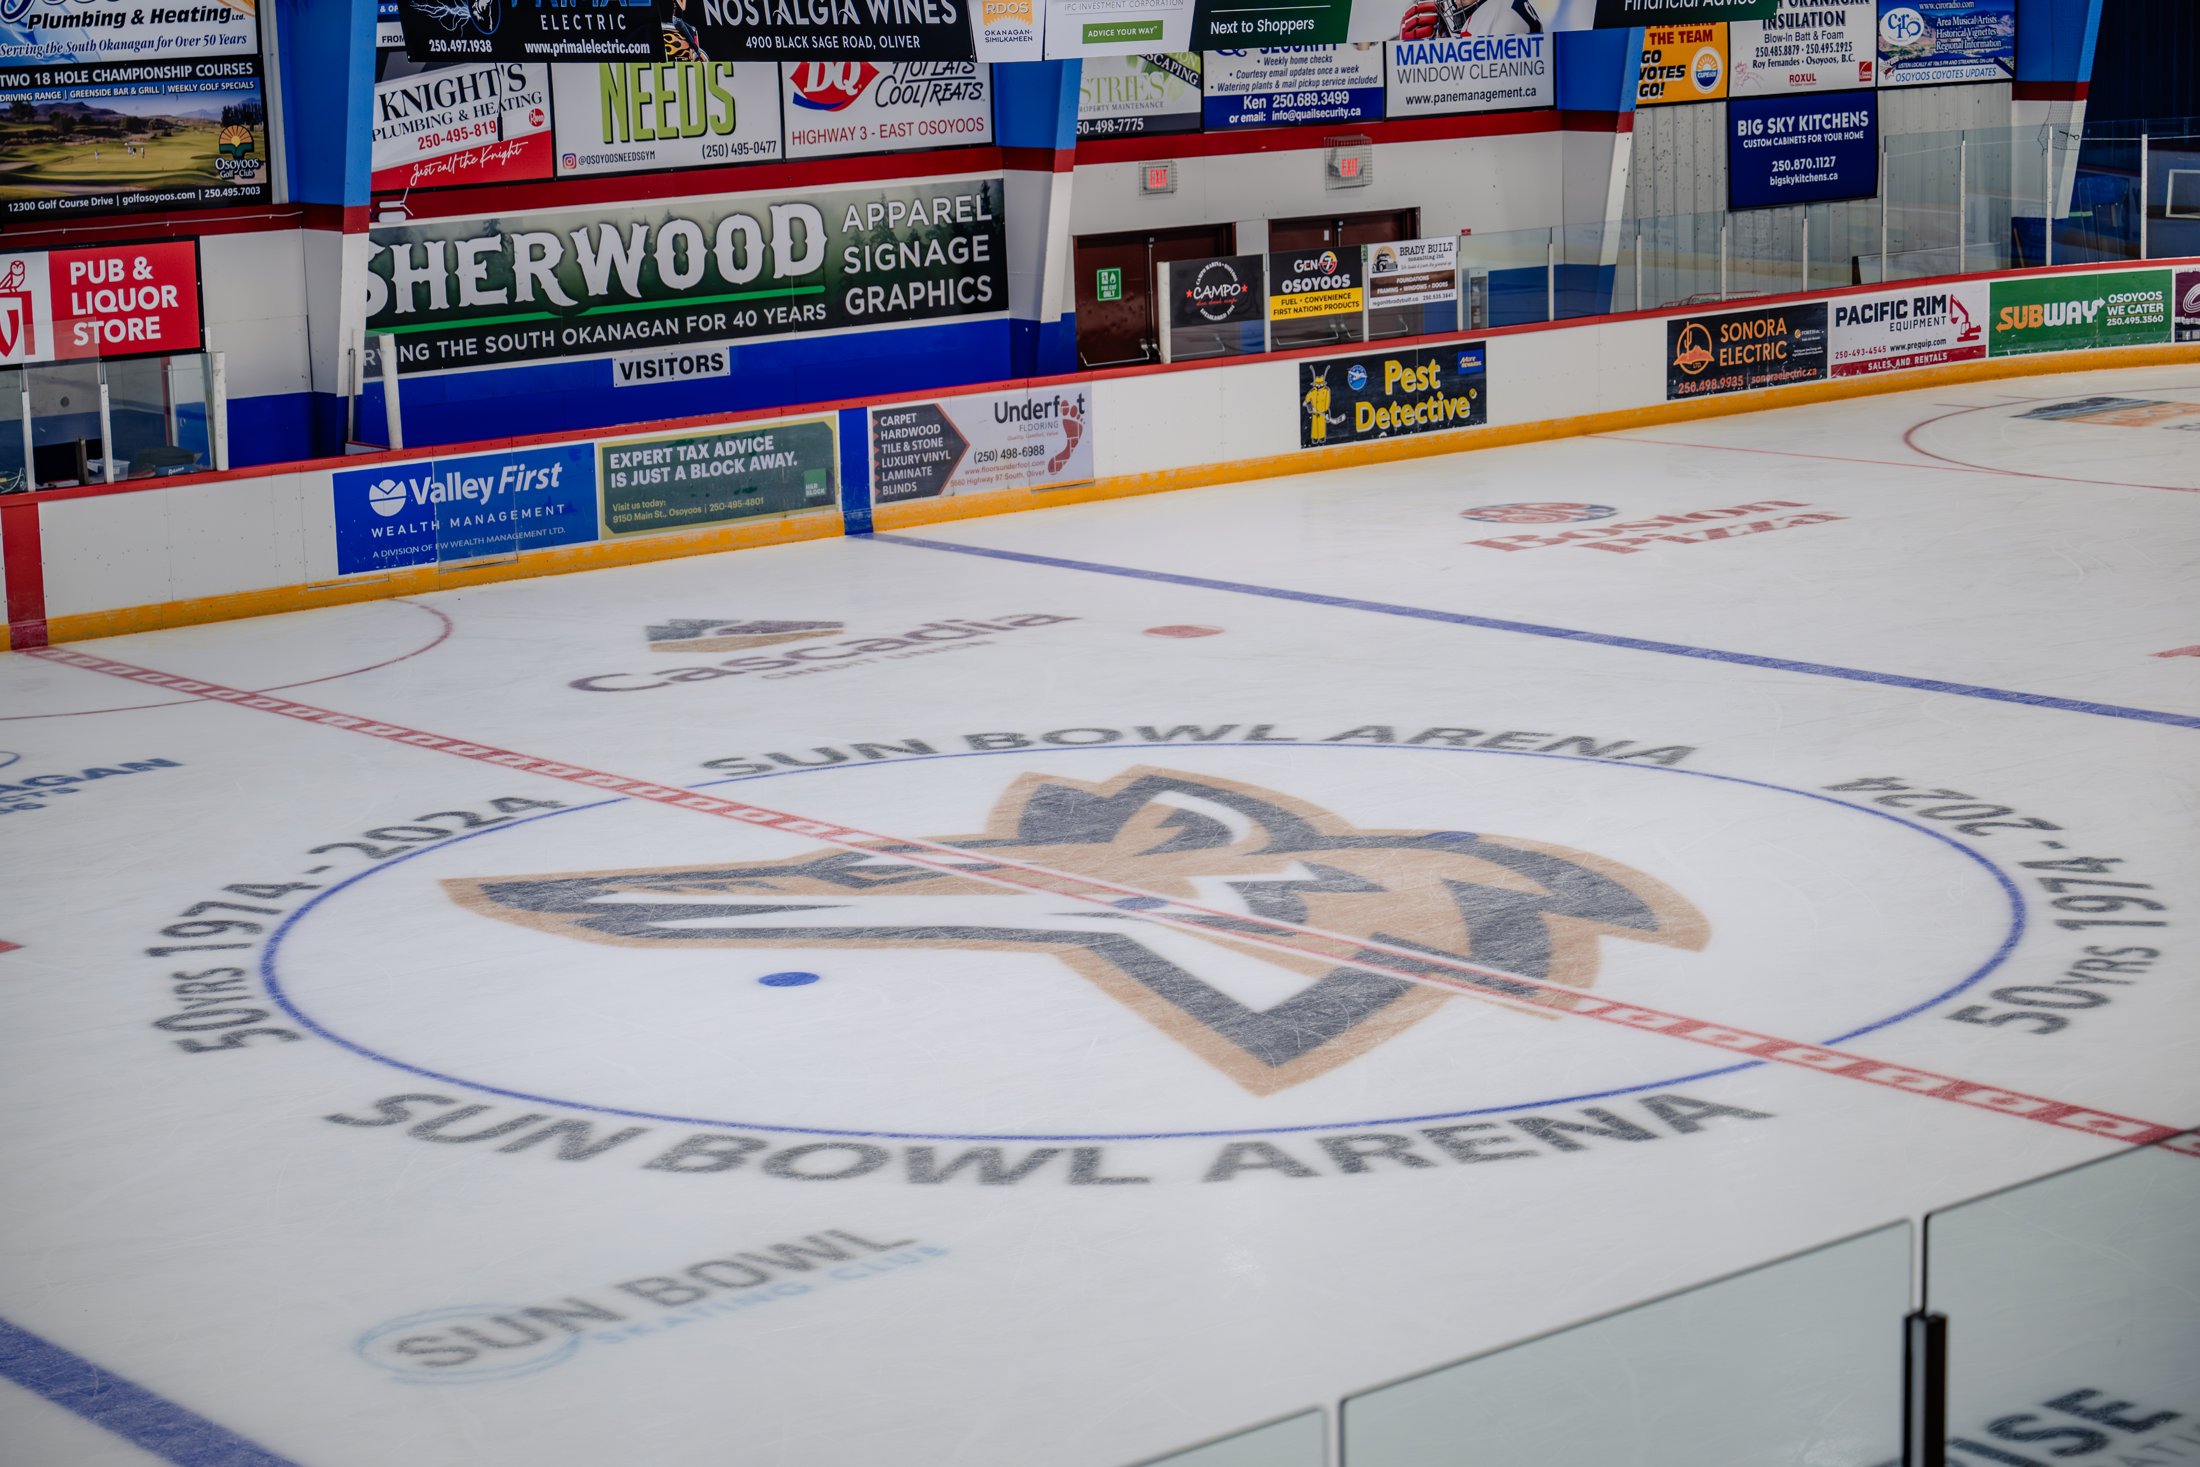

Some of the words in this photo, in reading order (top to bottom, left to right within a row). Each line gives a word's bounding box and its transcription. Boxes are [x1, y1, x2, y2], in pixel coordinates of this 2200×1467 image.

[985, 1, 1029, 15] RDOS
[540, 14, 627, 30] ELECTRIC
[1210, 20, 1238, 35] Next
[1241, 21, 1253, 33] to
[1257, 18, 1315, 35] Shoppers
[1762, 10, 1847, 30] INSULATION
[1, 43, 43, 58] Serving
[45, 42, 63, 53] the
[67, 39, 97, 52] South
[99, 37, 154, 53] Okanagan
[157, 36, 174, 52] for
[175, 35, 200, 48] Over
[203, 34, 216, 47] 50
[219, 33, 247, 46] Years
[429, 39, 492, 53] 250.497.1938
[746, 36, 773, 49] 4900
[775, 36, 810, 49] BLACK
[812, 36, 839, 49] SAGE
[842, 36, 876, 50] ROAD,
[879, 35, 920, 48] OLIVER
[1649, 32, 1675, 45] THE
[1678, 29, 1714, 43] TEAM
[525, 38, 650, 57] www.primalelectric.com
[1396, 37, 1545, 66] MANAGEMENT
[0, 74, 30, 87] TWO
[35, 73, 50, 85] 18
[55, 70, 88, 85] HOLE
[93, 65, 192, 83] CHAMPIONSHIP
[196, 63, 254, 78] COURSES
[1397, 64, 1466, 84] WINDOW
[1469, 60, 1545, 79] CLEANING
[1789, 73, 1817, 83] ROXUL
[1895, 71, 1931, 82] OSOYOOS
[1932, 69, 1964, 80] COYOTES
[1965, 68, 1997, 78] UPDATES
[378, 64, 527, 122] KNIGHT'S
[1243, 95, 1267, 110] Ken
[1272, 91, 1350, 109] 250.689.3499
[1405, 87, 1537, 105] www.panemanagement.ca
[600, 62, 738, 146] NEEDS
[372, 111, 453, 142] PLUMBING
[458, 109, 469, 121] &
[473, 91, 543, 117] HEATING
[1229, 114, 1238, 123] or
[1240, 112, 1266, 123] email:
[1272, 107, 1361, 121] info@quailsecurity.ca
[1737, 119, 1763, 137] BIG
[1768, 116, 1795, 134] SKY
[1799, 111, 1869, 132] KITCHENS
[792, 126, 857, 146] HIGHWAY
[859, 125, 868, 140] 3
[879, 122, 914, 140] EAST
[918, 117, 985, 136] OSOYOOS
[1743, 138, 1772, 148] CUSTOM
[1773, 136, 1807, 147] CABINETS
[1808, 135, 1822, 144] FOR
[1823, 133, 1843, 142] YOUR
[1844, 130, 1864, 141] HOME
[701, 143, 729, 160] (250)
[730, 140, 777, 157] 495-0477
[215, 157, 259, 172] Osoyoos
[1341, 158, 1359, 177] EXIT
[1772, 156, 1837, 173] 250.870.1127
[1149, 168, 1168, 188] EXIT
[1769, 172, 1838, 187] bigskykitchens.ca
[122, 191, 195, 206] golfosoyoos.com
[204, 186, 261, 199] 250.495.7003
[8, 202, 36, 213] 12300
[38, 200, 57, 211] Golf
[58, 198, 89, 209] Course
[91, 196, 113, 208] Drive
[842, 194, 992, 233] APPAREL
[843, 234, 991, 275] SIGNAGE
[1400, 245, 1426, 256] BRADY
[1427, 242, 1454, 253] BUILT
[70, 258, 125, 286] PUB
[132, 256, 154, 281] &
[1193, 283, 1241, 299] CAMPO
[1282, 273, 1351, 294] OSOYOOS
[72, 284, 179, 316] LIQUOR
[845, 275, 993, 316] GRAPHICS
[1281, 298, 1298, 306] FUEL
[1304, 292, 1352, 304] CONVENIENCE
[2107, 290, 2163, 304] OSOYOOS
[1273, 307, 1292, 316] FIRST
[1293, 304, 1323, 313] NATIONS
[1324, 300, 1360, 310] PRODUCTS
[1835, 299, 1908, 327] PACIFIC
[1913, 294, 1947, 317] RIM
[1996, 297, 2106, 332] SUBWAY
[2107, 305, 2125, 316] WE
[2127, 303, 2164, 314] CATER
[1720, 317, 1788, 343] SONORA
[1889, 316, 1946, 332] EQUIPMENT
[2106, 314, 2164, 326] 250.495.3560
[73, 315, 162, 346] STORE
[437, 337, 478, 359] THE
[485, 329, 555, 354] SOUTH
[561, 317, 679, 346] OKANAGAN
[686, 312, 727, 333] FOR
[733, 310, 757, 328] 40
[764, 303, 827, 324] YEARS
[1719, 340, 1788, 367] ELECTRIC
[1835, 345, 1887, 360] 250-493-4545
[1889, 338, 1947, 353] www.prequip.com
[619, 352, 724, 381] VISITORS
[1867, 360, 1892, 371] SALES
[1895, 357, 1911, 367] AND
[1914, 351, 1948, 365] RENTALS
[1384, 359, 1442, 395] Pest
[1678, 375, 1744, 395] 250.498.9935
[1751, 367, 1818, 385] sonoraelectric.ca
[880, 413, 917, 427] CARPET
[1355, 391, 1471, 433] Detective
[880, 424, 941, 440] HARDWOOD
[1019, 421, 1059, 432] FLOORING
[610, 447, 674, 469] EXPERT
[676, 443, 710, 461] TAX
[713, 435, 774, 457] ADVICE
[882, 443, 901, 454] TILE
[903, 442, 911, 451] &
[912, 437, 944, 450] STONE
[974, 451, 998, 464] (250)
[1000, 445, 1045, 460] 498-6988
[882, 454, 922, 468] LUXURY
[923, 450, 951, 463] VINYL
[611, 473, 627, 488] IS
[630, 467, 668, 486] JUST
[674, 466, 686, 481] A
[690, 458, 745, 480] BLOCK
[749, 451, 798, 471] AWAY.
[882, 466, 933, 481] LAMINATE
[409, 472, 494, 506] Valley
[498, 462, 563, 494] First
[882, 482, 917, 495] BLINDS
[371, 519, 440, 538] WEALTH
[450, 504, 565, 528] MANAGEMENT
[1461, 500, 1814, 552] Boston
[1574, 511, 1850, 554] Pizza
[568, 613, 1083, 693] Cascadia
[702, 738, 939, 777] SUN
[963, 723, 1299, 751] BOWL
[1321, 724, 1698, 765] ARENA
[322, 1092, 650, 1161] SUN
[640, 1133, 1152, 1185] BOWL
[1200, 1093, 1777, 1182] ARENA
[395, 1296, 628, 1367] SUN
[616, 1228, 918, 1307] BOWL
